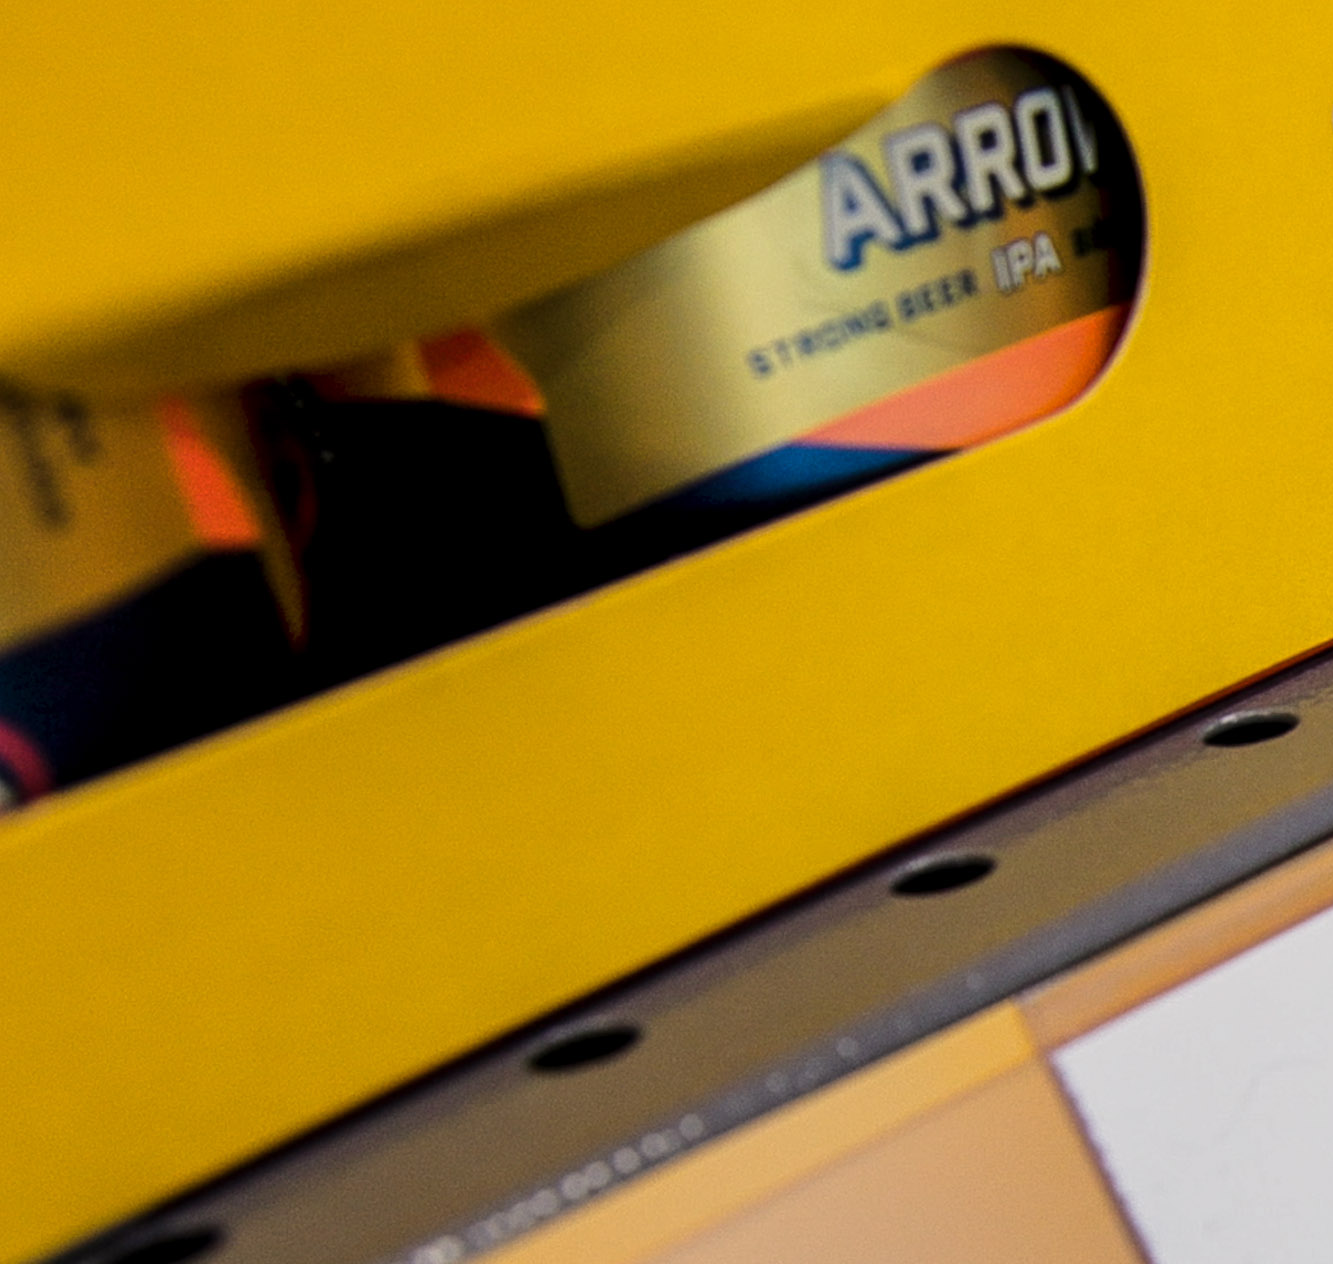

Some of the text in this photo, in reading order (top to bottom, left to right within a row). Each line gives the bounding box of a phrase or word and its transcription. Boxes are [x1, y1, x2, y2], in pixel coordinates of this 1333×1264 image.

[746, 299, 892, 378] STRONG
[897, 269, 978, 322] BEER
[991, 231, 1062, 294] IPA
